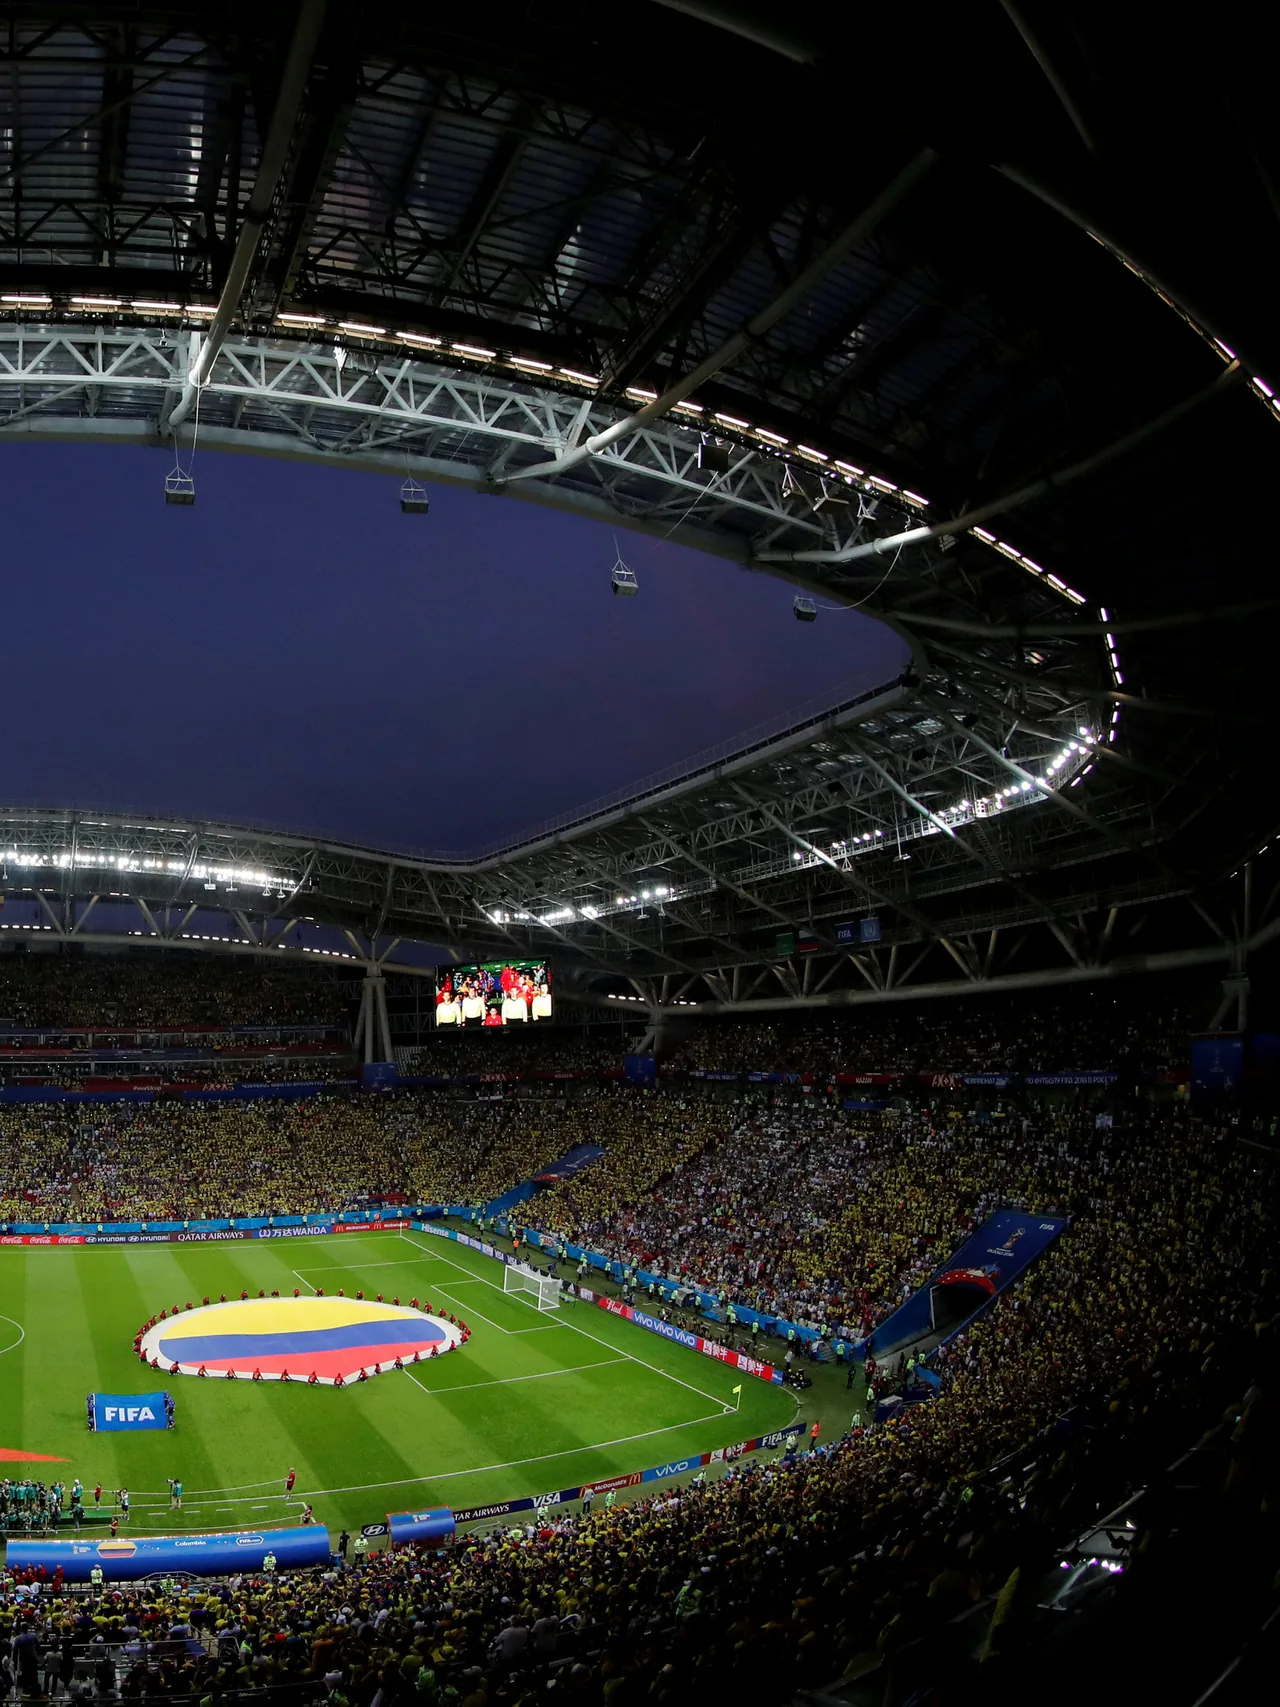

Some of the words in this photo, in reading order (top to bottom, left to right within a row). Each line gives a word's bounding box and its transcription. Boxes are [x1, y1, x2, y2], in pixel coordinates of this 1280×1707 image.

[837, 929, 852, 940] FIFA
[292, 1226, 327, 1236] WANDA
[421, 1223, 450, 1238] Hisense
[1039, 1223, 1055, 1231] FIFA
[140, 1234, 169, 1242] HYUNDAI
[178, 1232, 207, 1242] QATAR
[208, 1230, 244, 1240] AIRWAYS
[606, 1298, 622, 1315] Bud
[104, 1407, 156, 1422] FIFA
[532, 1492, 561, 1507] VISA
[454, 1511, 471, 1521] TAR
[472, 1504, 510, 1518] AIRWAYS
